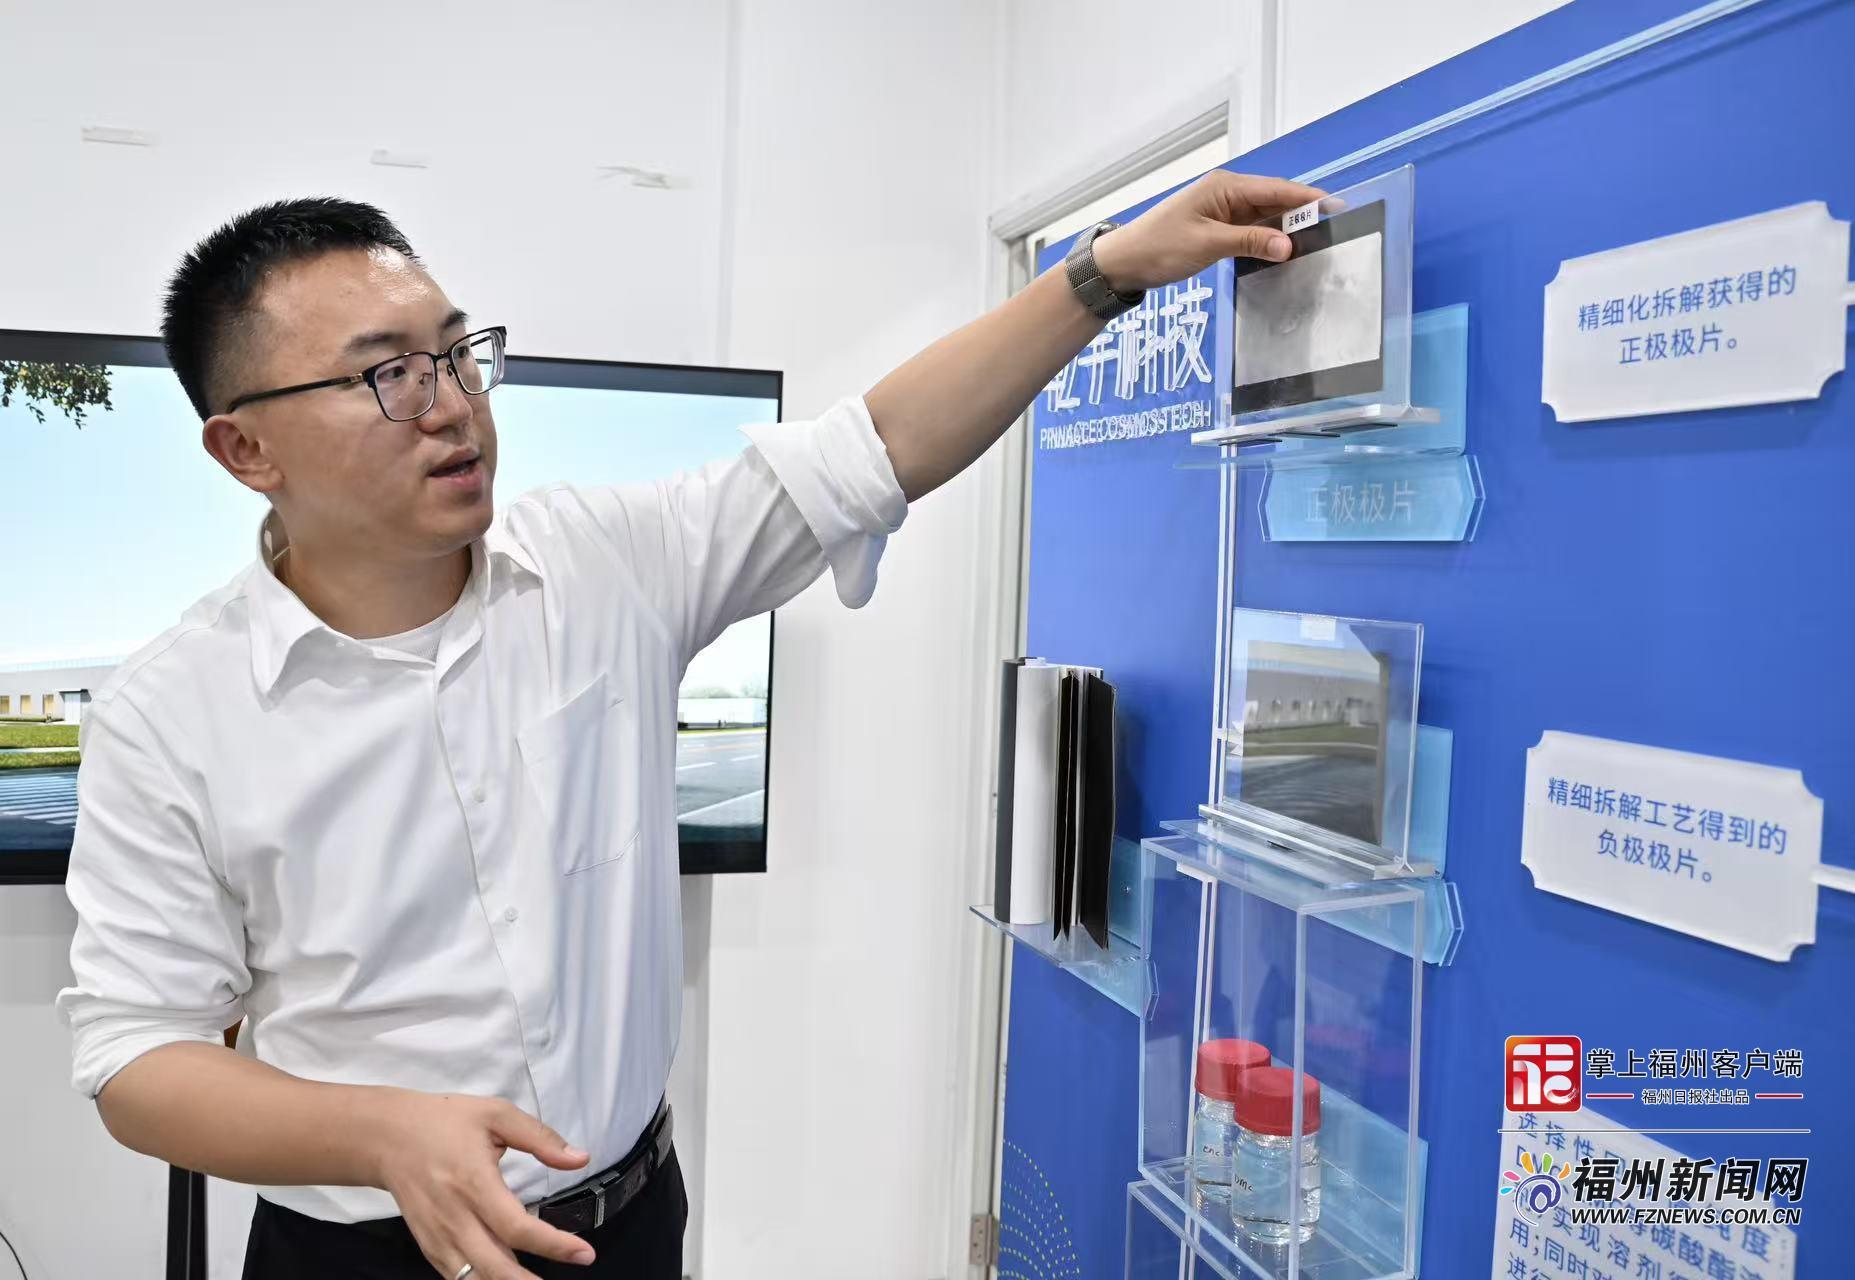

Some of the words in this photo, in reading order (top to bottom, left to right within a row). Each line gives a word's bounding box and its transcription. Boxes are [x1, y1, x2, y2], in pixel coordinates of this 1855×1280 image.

[1288, 208, 1312, 227] 正极极片
[1577, 264, 1797, 331] 精细化拆解获得的
[1618, 324, 1739, 365] 正极极片。
[1303, 479, 1417, 525] 正极极片
[1547, 776, 1788, 856] 精细拆解工艺得到的
[1596, 828, 1714, 884] 负极极片。
